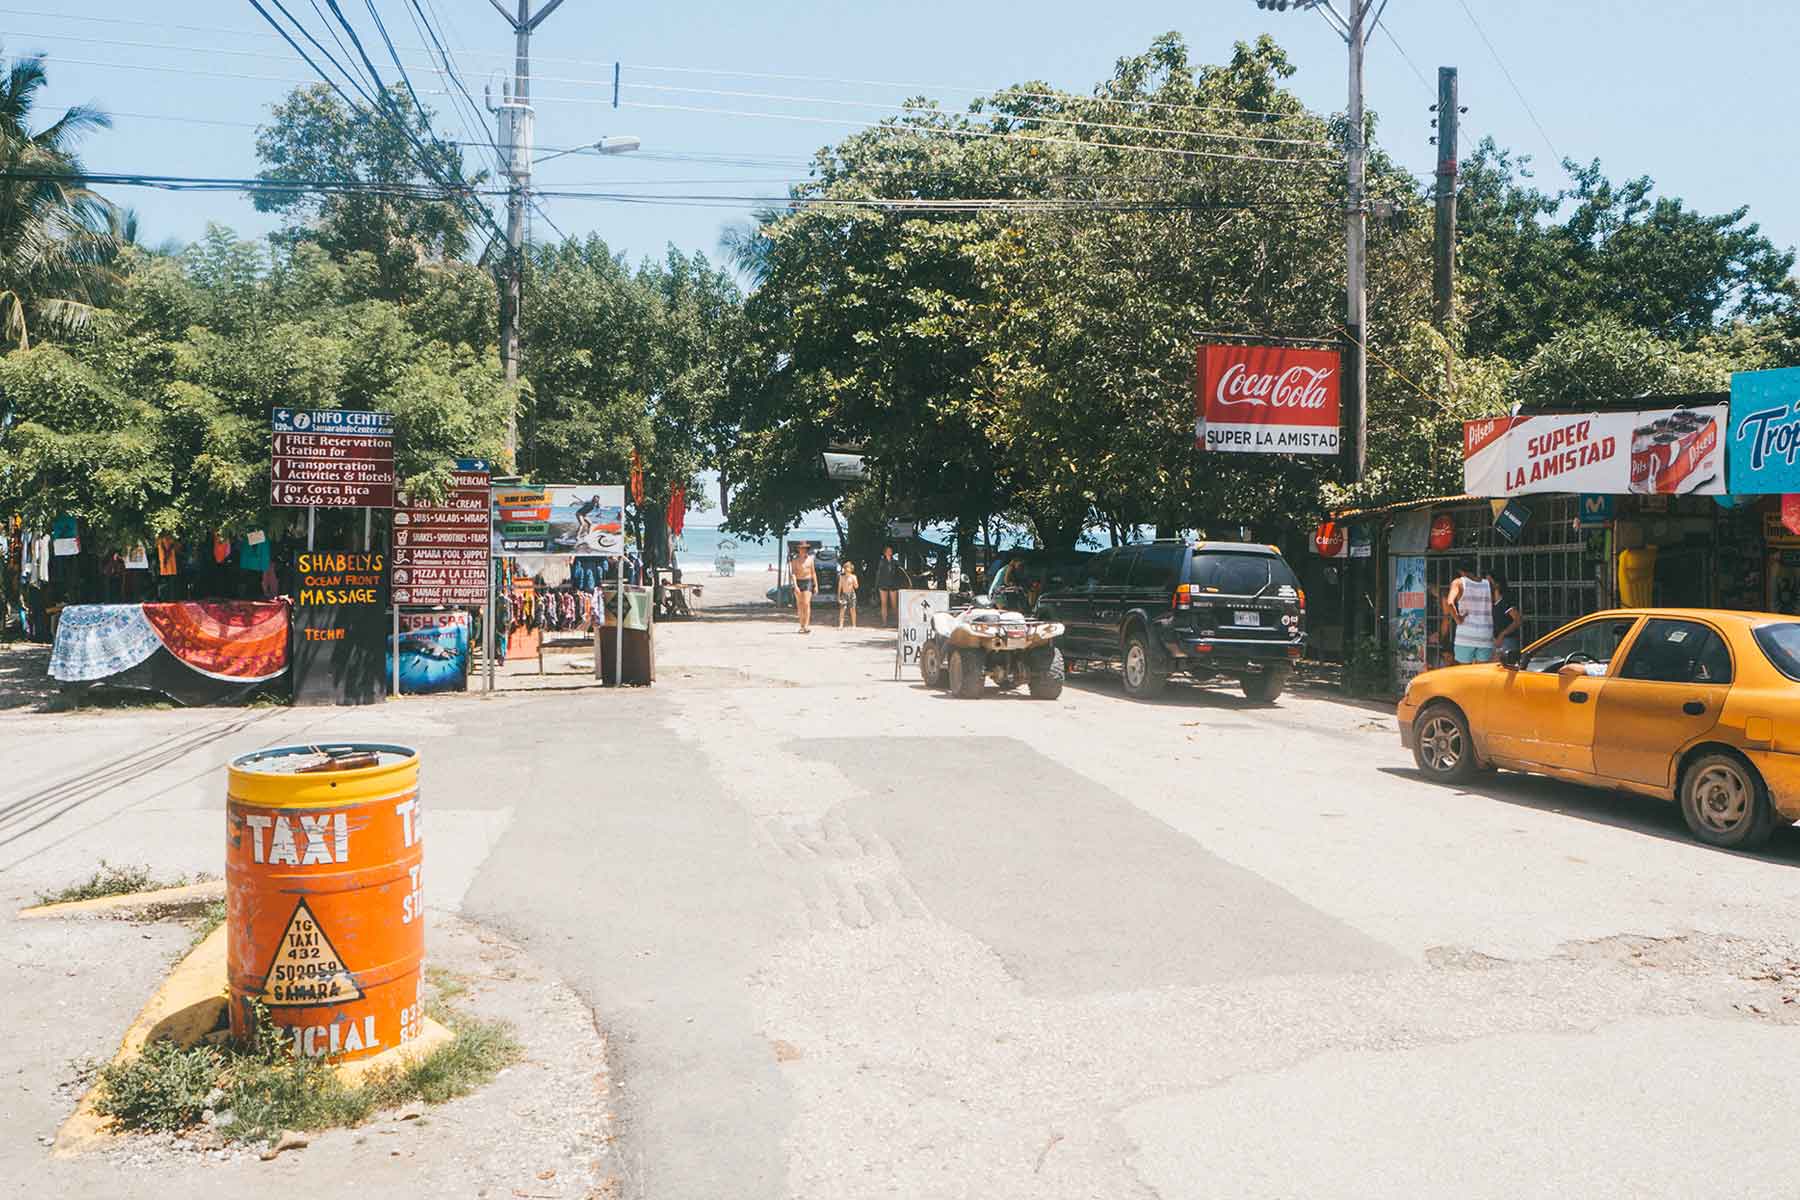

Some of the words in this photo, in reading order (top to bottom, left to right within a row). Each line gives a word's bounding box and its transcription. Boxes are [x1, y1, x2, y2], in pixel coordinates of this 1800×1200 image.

[1216, 363, 1335, 408] Coca-Cola
[312, 411, 342, 424] INFO
[286, 435, 317, 445] FREE
[320, 436, 392, 448] Reservation
[1207, 430, 1252, 444] SUPER
[1256, 431, 1273, 445] LA
[1277, 432, 1338, 447] AMISTAD
[1468, 420, 1494, 451] Pilsen
[1527, 420, 1591, 459] SUPER
[286, 445, 327, 456] Station
[329, 446, 347, 457] for
[286, 459, 376, 472] Transportation
[1505, 466, 1526, 491] LA
[1529, 436, 1616, 484] AMISTAD
[288, 470, 340, 481] Activities
[343, 471, 354, 481] &
[358, 472, 392, 482] Hotels
[284, 483, 303, 494] for
[307, 484, 340, 495] Costa
[344, 485, 370, 495] Rica
[295, 494, 323, 505] 2656
[327, 495, 357, 505] 2424
[456, 499, 482, 508] CREAM
[1315, 535, 1337, 545] Claro
[442, 549, 462, 559] POOL
[463, 549, 488, 559] SUPPLY
[304, 575, 342, 586] OCEAN
[345, 574, 381, 585] FRONT
[412, 569, 438, 578] PIZZA
[439, 569, 446, 578] A
[449, 569, 460, 578] LA
[300, 588, 377, 606] MASSAGE
[412, 588, 441, 597] MANAGE
[454, 588, 488, 598] PROPERTY
[399, 615, 434, 629] FISH
[903, 627, 917, 641] NO
[246, 813, 348, 864] TAXI
[294, 920, 313, 931] TG
[288, 933, 318, 947] TAXI
[288, 949, 320, 960] 432
